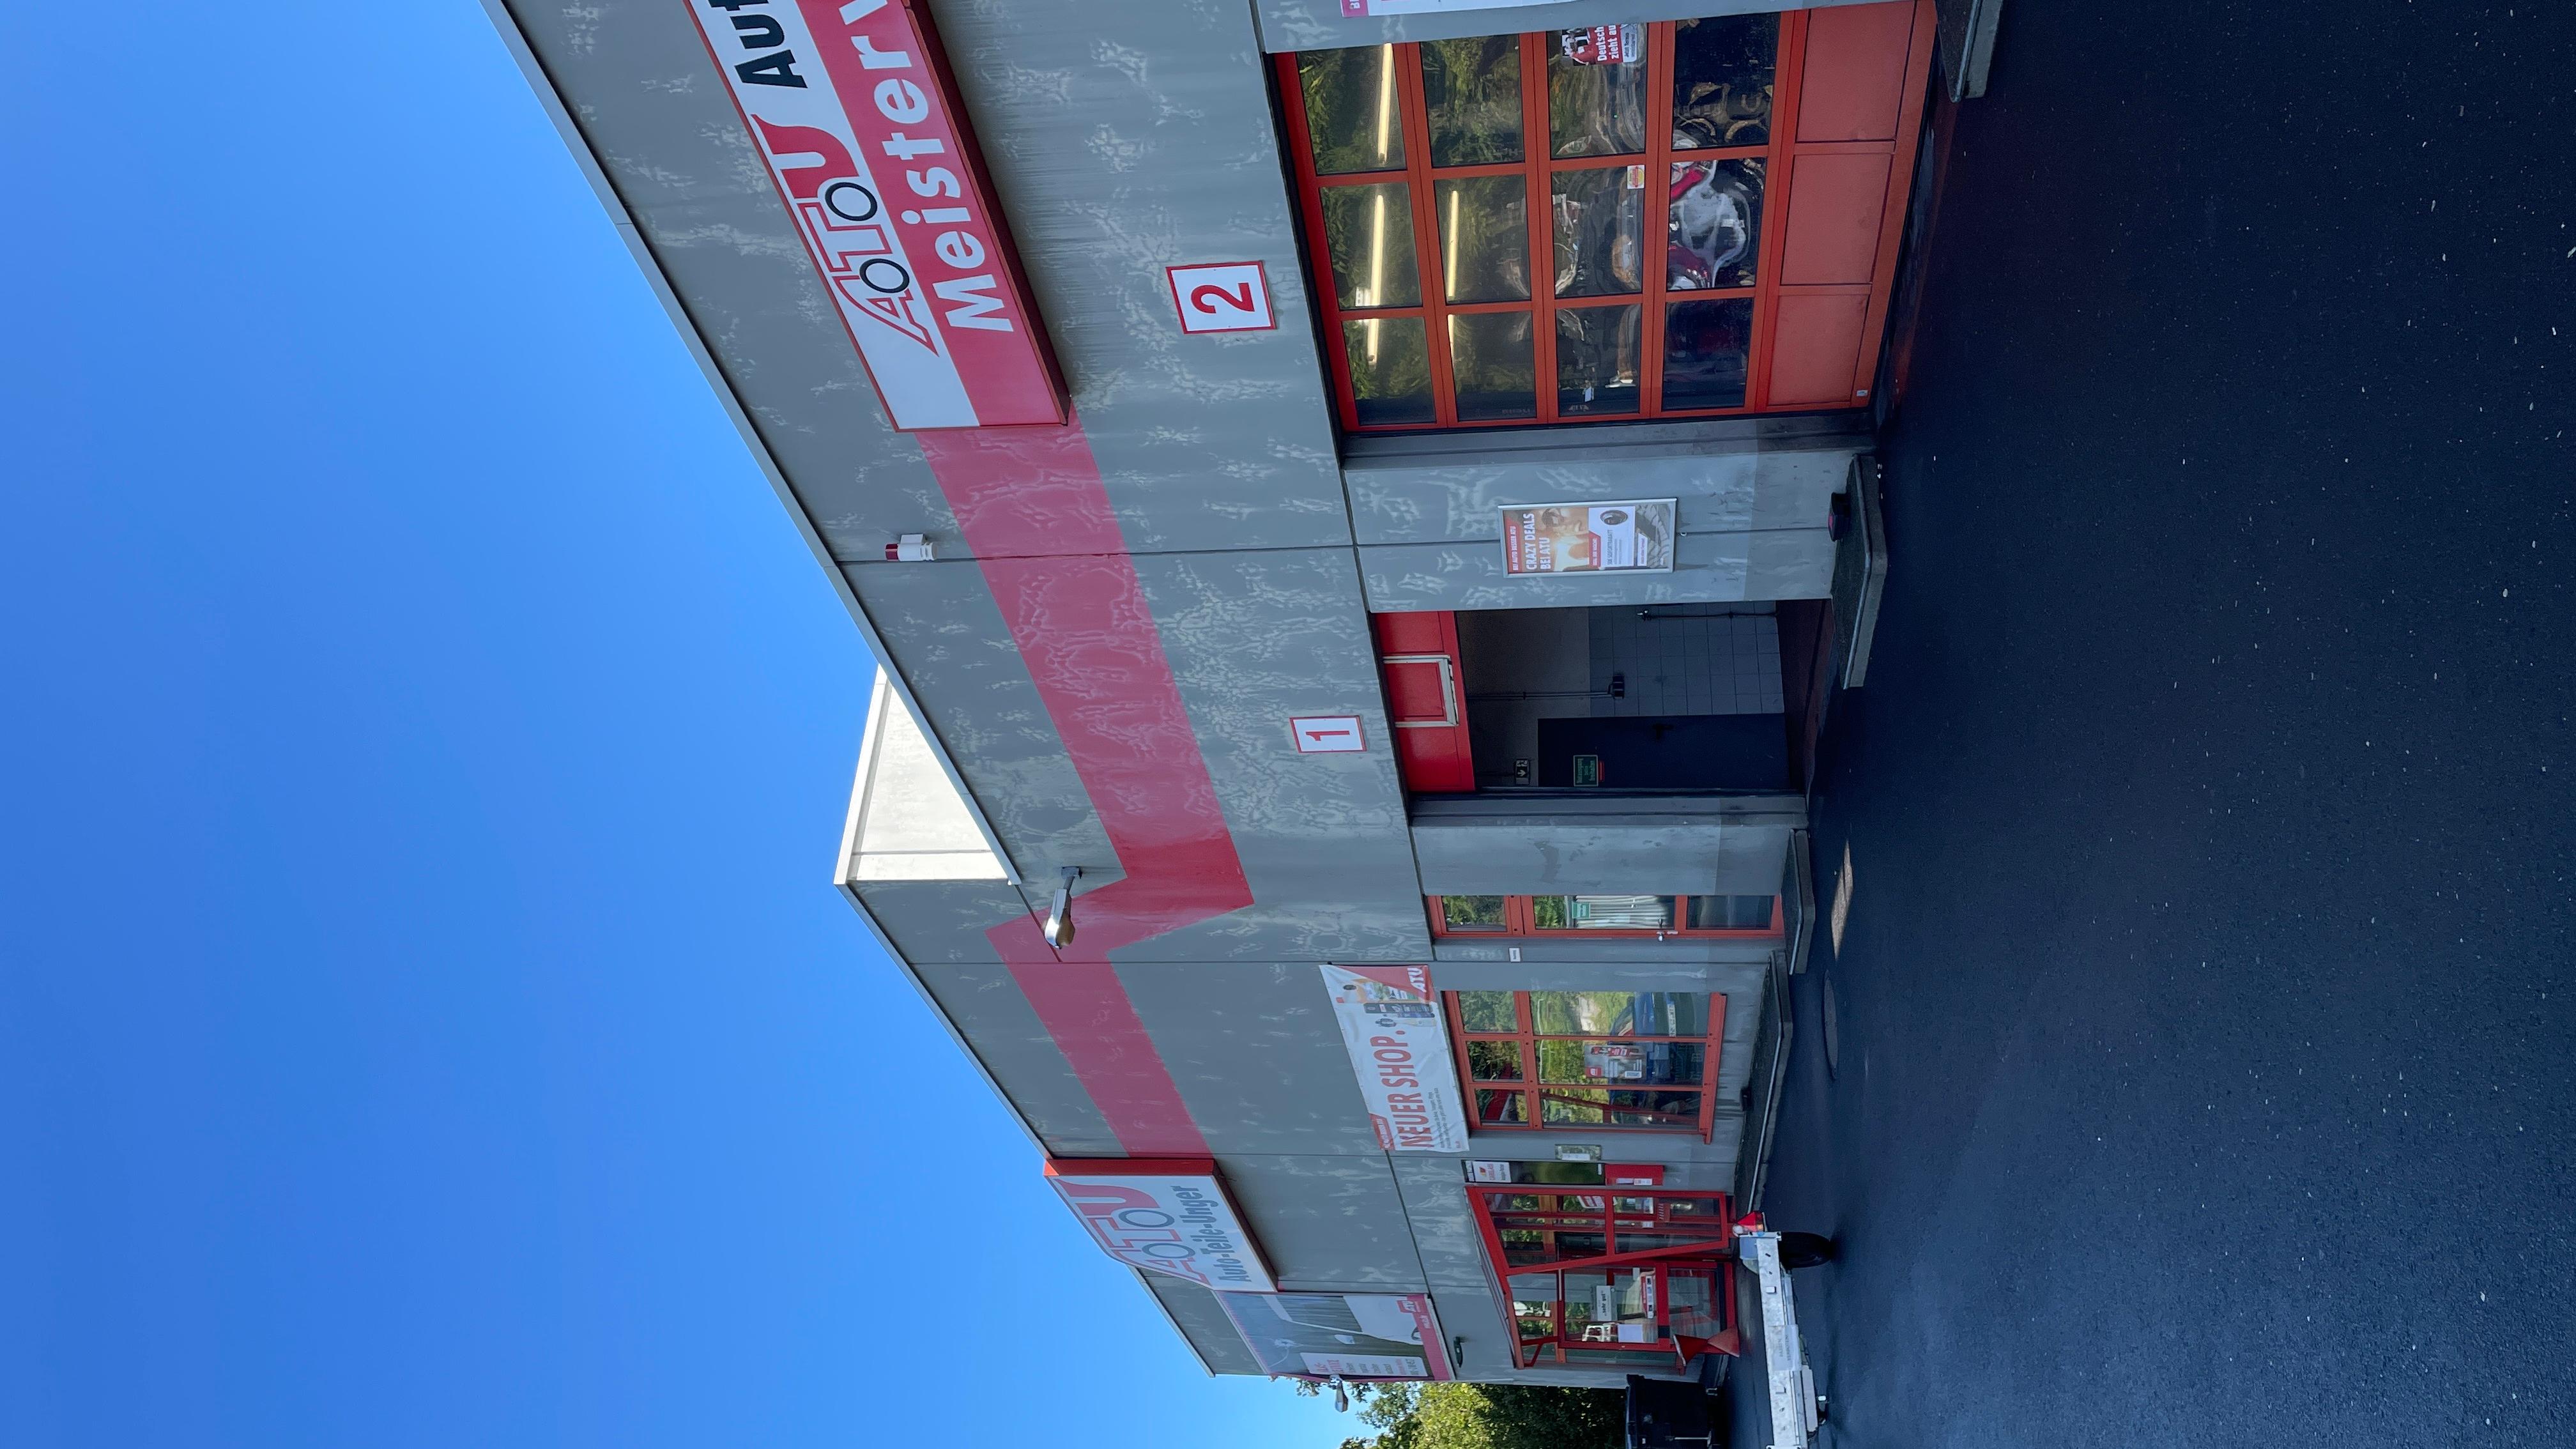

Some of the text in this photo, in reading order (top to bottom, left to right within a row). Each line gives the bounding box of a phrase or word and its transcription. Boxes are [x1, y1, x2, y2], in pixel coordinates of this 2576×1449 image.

[1594, 26, 1607, 61] Deutsch
[1607, 37, 1619, 59] zieht
[1191, 283, 1255, 314] 2
[1523, 514, 1537, 570] CRAZY DEALS
[1538, 537, 1551, 569] BEI ATU
[1305, 730, 1351, 742] 1
[1407, 967, 1427, 993] ATU
[1370, 1030, 1434, 1147] NEUER SHOP.
[1170, 1186, 1252, 1282] Auto-Teile-Unger
